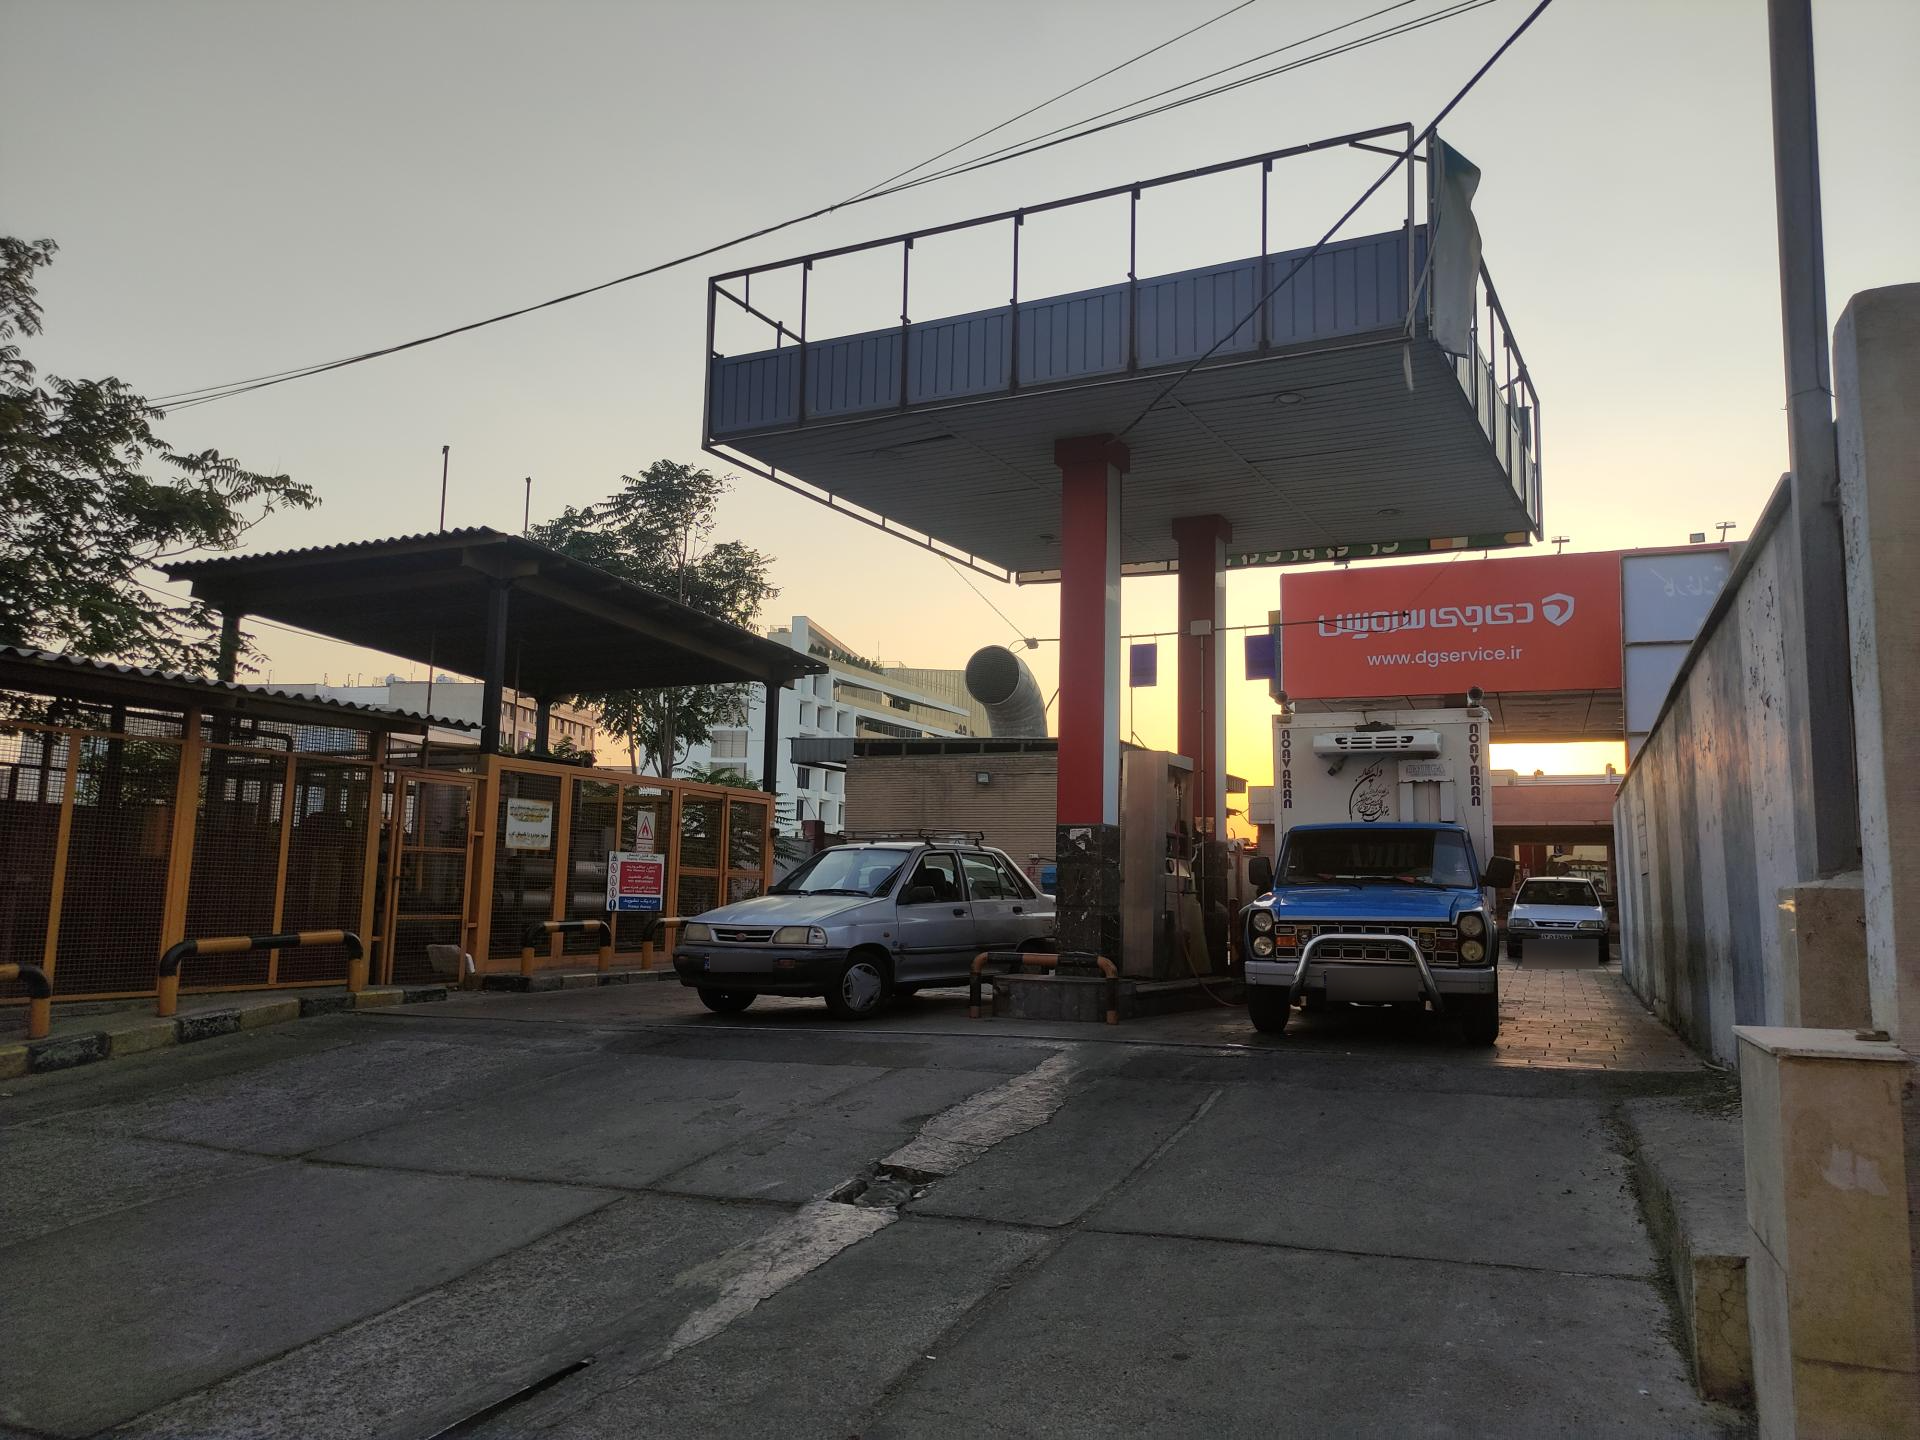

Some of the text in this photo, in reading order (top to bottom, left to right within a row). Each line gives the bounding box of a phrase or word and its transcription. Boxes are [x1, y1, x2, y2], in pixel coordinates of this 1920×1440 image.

[1318, 602, 1534, 640] دی جی سرویس
[1367, 645, 1523, 668] www.dgservice.ir
